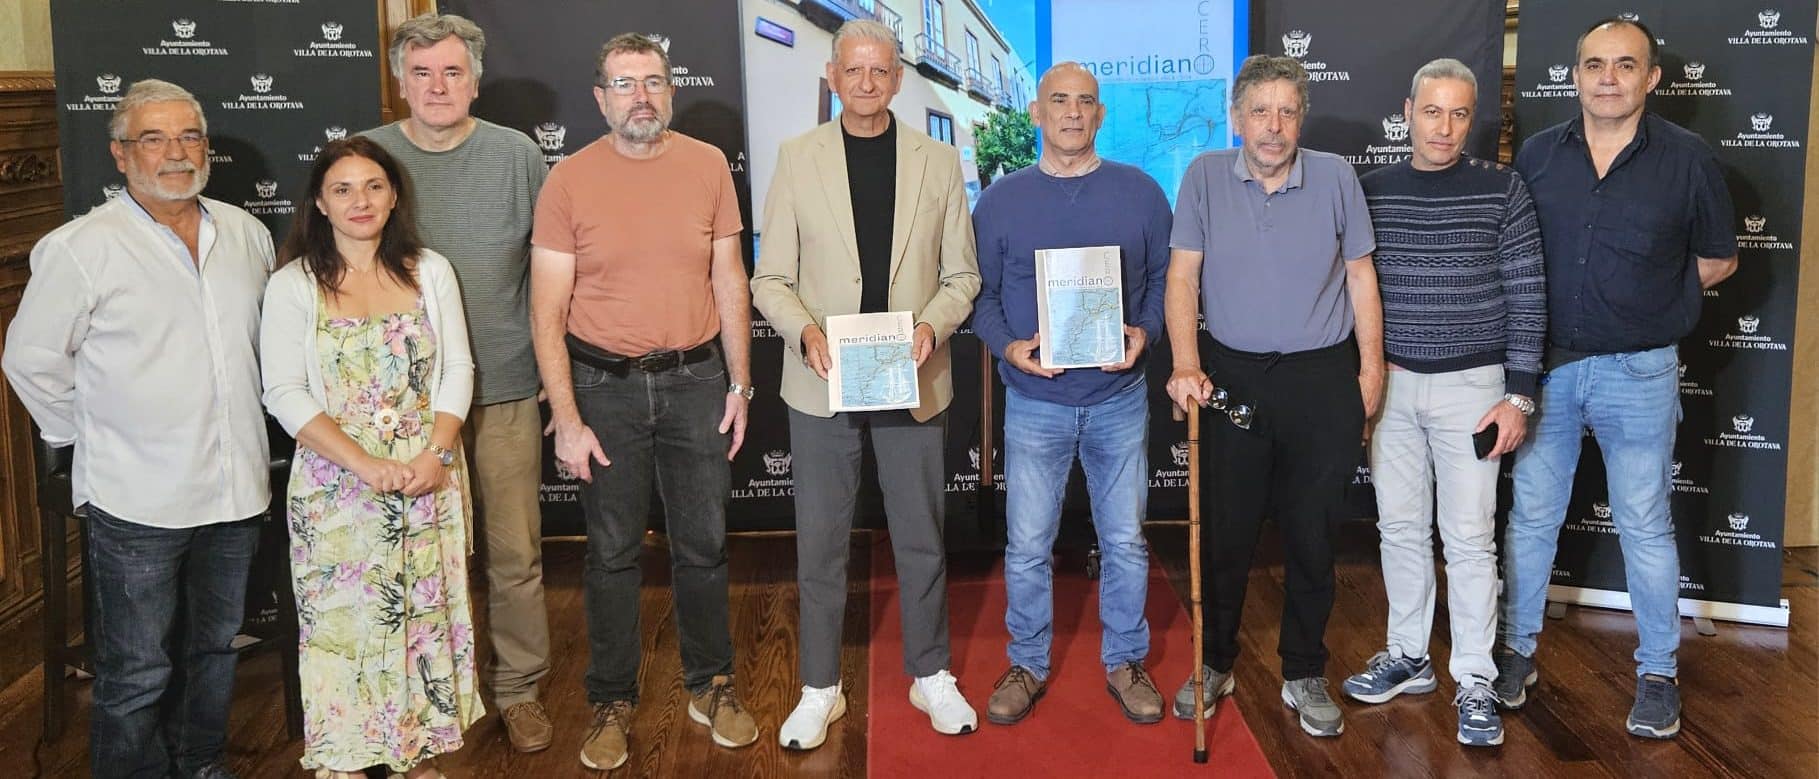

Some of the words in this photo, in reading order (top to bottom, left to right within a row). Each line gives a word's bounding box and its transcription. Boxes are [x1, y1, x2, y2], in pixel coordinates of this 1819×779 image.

[192, 48, 229, 56] OROTAVA
[340, 50, 372, 58] OROTAVA
[672, 76, 714, 87] ROTAVA
[1537, 83, 1576, 91] Ayuntamient
[269, 102, 304, 110] OROTAVA
[1366, 144, 1412, 154] Ayuntamie
[1374, 155, 1388, 164] DE
[1389, 155, 1402, 164] LA
[753, 328, 764, 337] DE
[1725, 334, 1771, 342] Ayuntamiento
[1754, 342, 1787, 350] OROTAVA
[1720, 432, 1765, 441] Ayuntamiento
[1748, 441, 1781, 450] OROTAVA
[1164, 478, 1176, 488] DE
[540, 484, 579, 492] Ayuntam
[732, 490, 754, 498] ILLA
[757, 488, 770, 497] DE
[772, 488, 785, 497] LA
[1715, 530, 1760, 539] Ayuntamiento
[1744, 539, 1776, 548] OROTAVA
